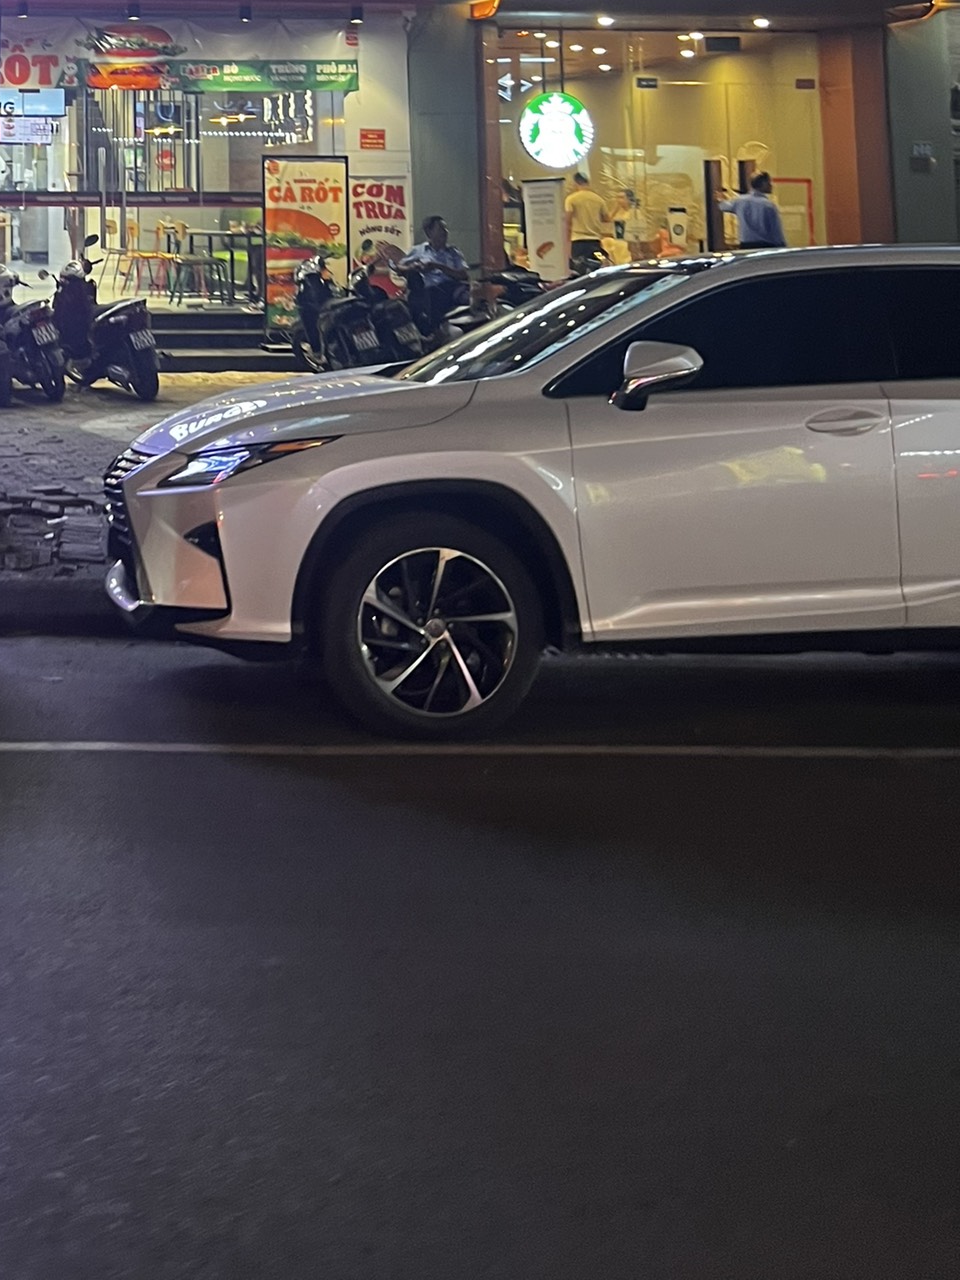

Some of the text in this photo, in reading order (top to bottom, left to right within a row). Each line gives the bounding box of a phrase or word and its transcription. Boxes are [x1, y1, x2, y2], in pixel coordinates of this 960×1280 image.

[268, 177, 343, 203] CÀ RỐT
[352, 183, 406, 207] CƠM
[352, 201, 407, 220] TRƯA
